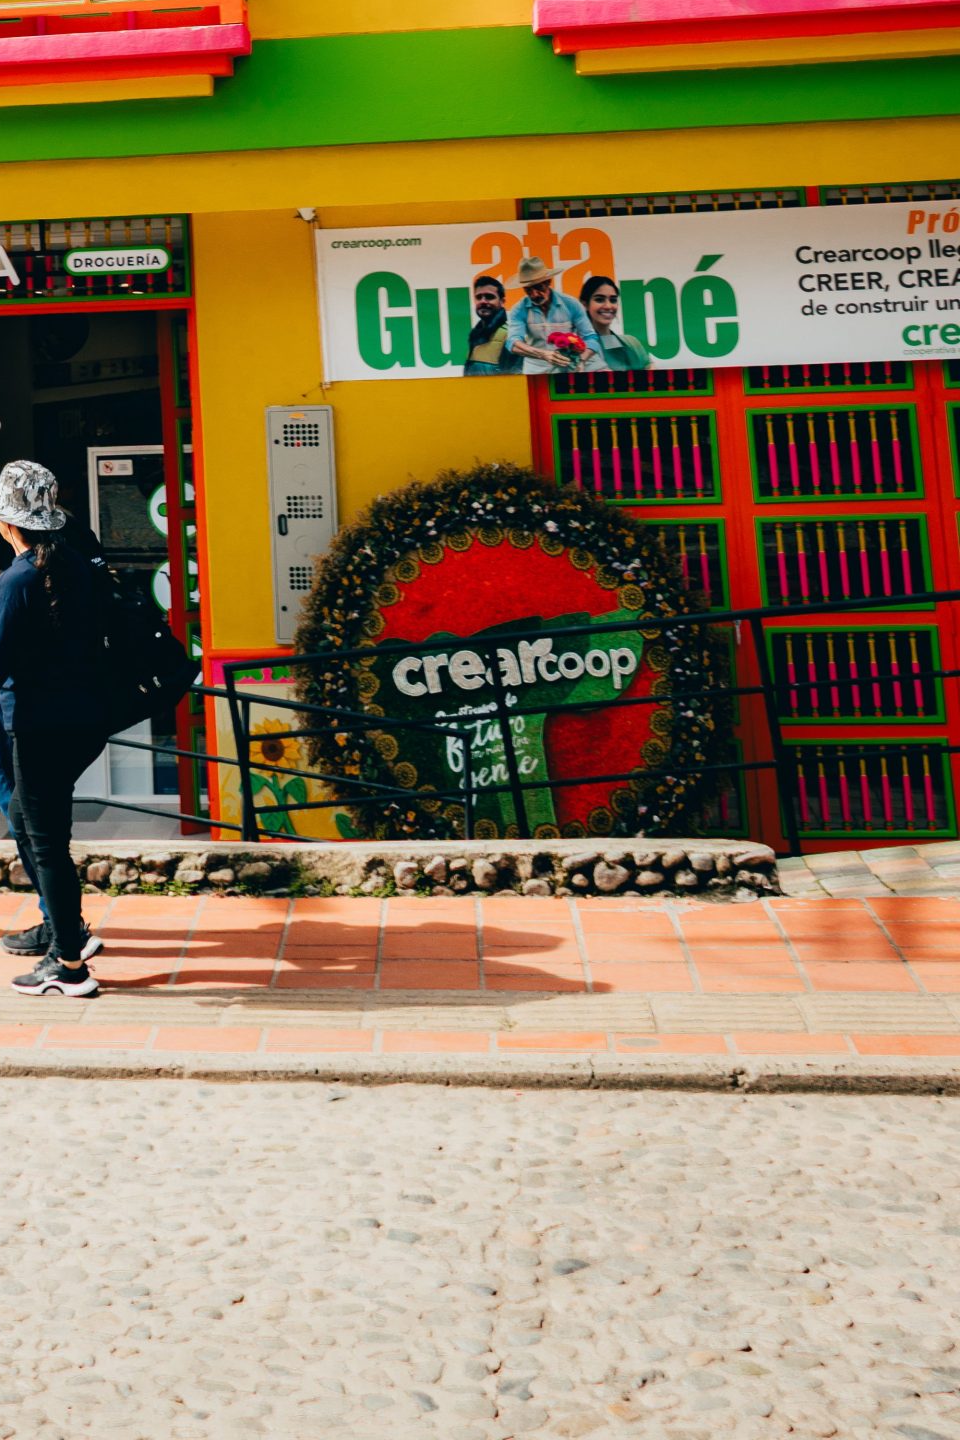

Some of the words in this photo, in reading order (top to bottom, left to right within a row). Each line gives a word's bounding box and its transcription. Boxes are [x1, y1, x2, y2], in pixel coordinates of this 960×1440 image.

[331, 237, 422, 250] crearcoop.com
[795, 245, 922, 265] Crearcoop
[928, 238, 960, 262] lle
[73, 252, 161, 269] DROGUERÍA
[798, 271, 890, 293] CREER,
[801, 299, 828, 316] de
[835, 295, 929, 315] construir
[392, 637, 638, 697] crearcoop
